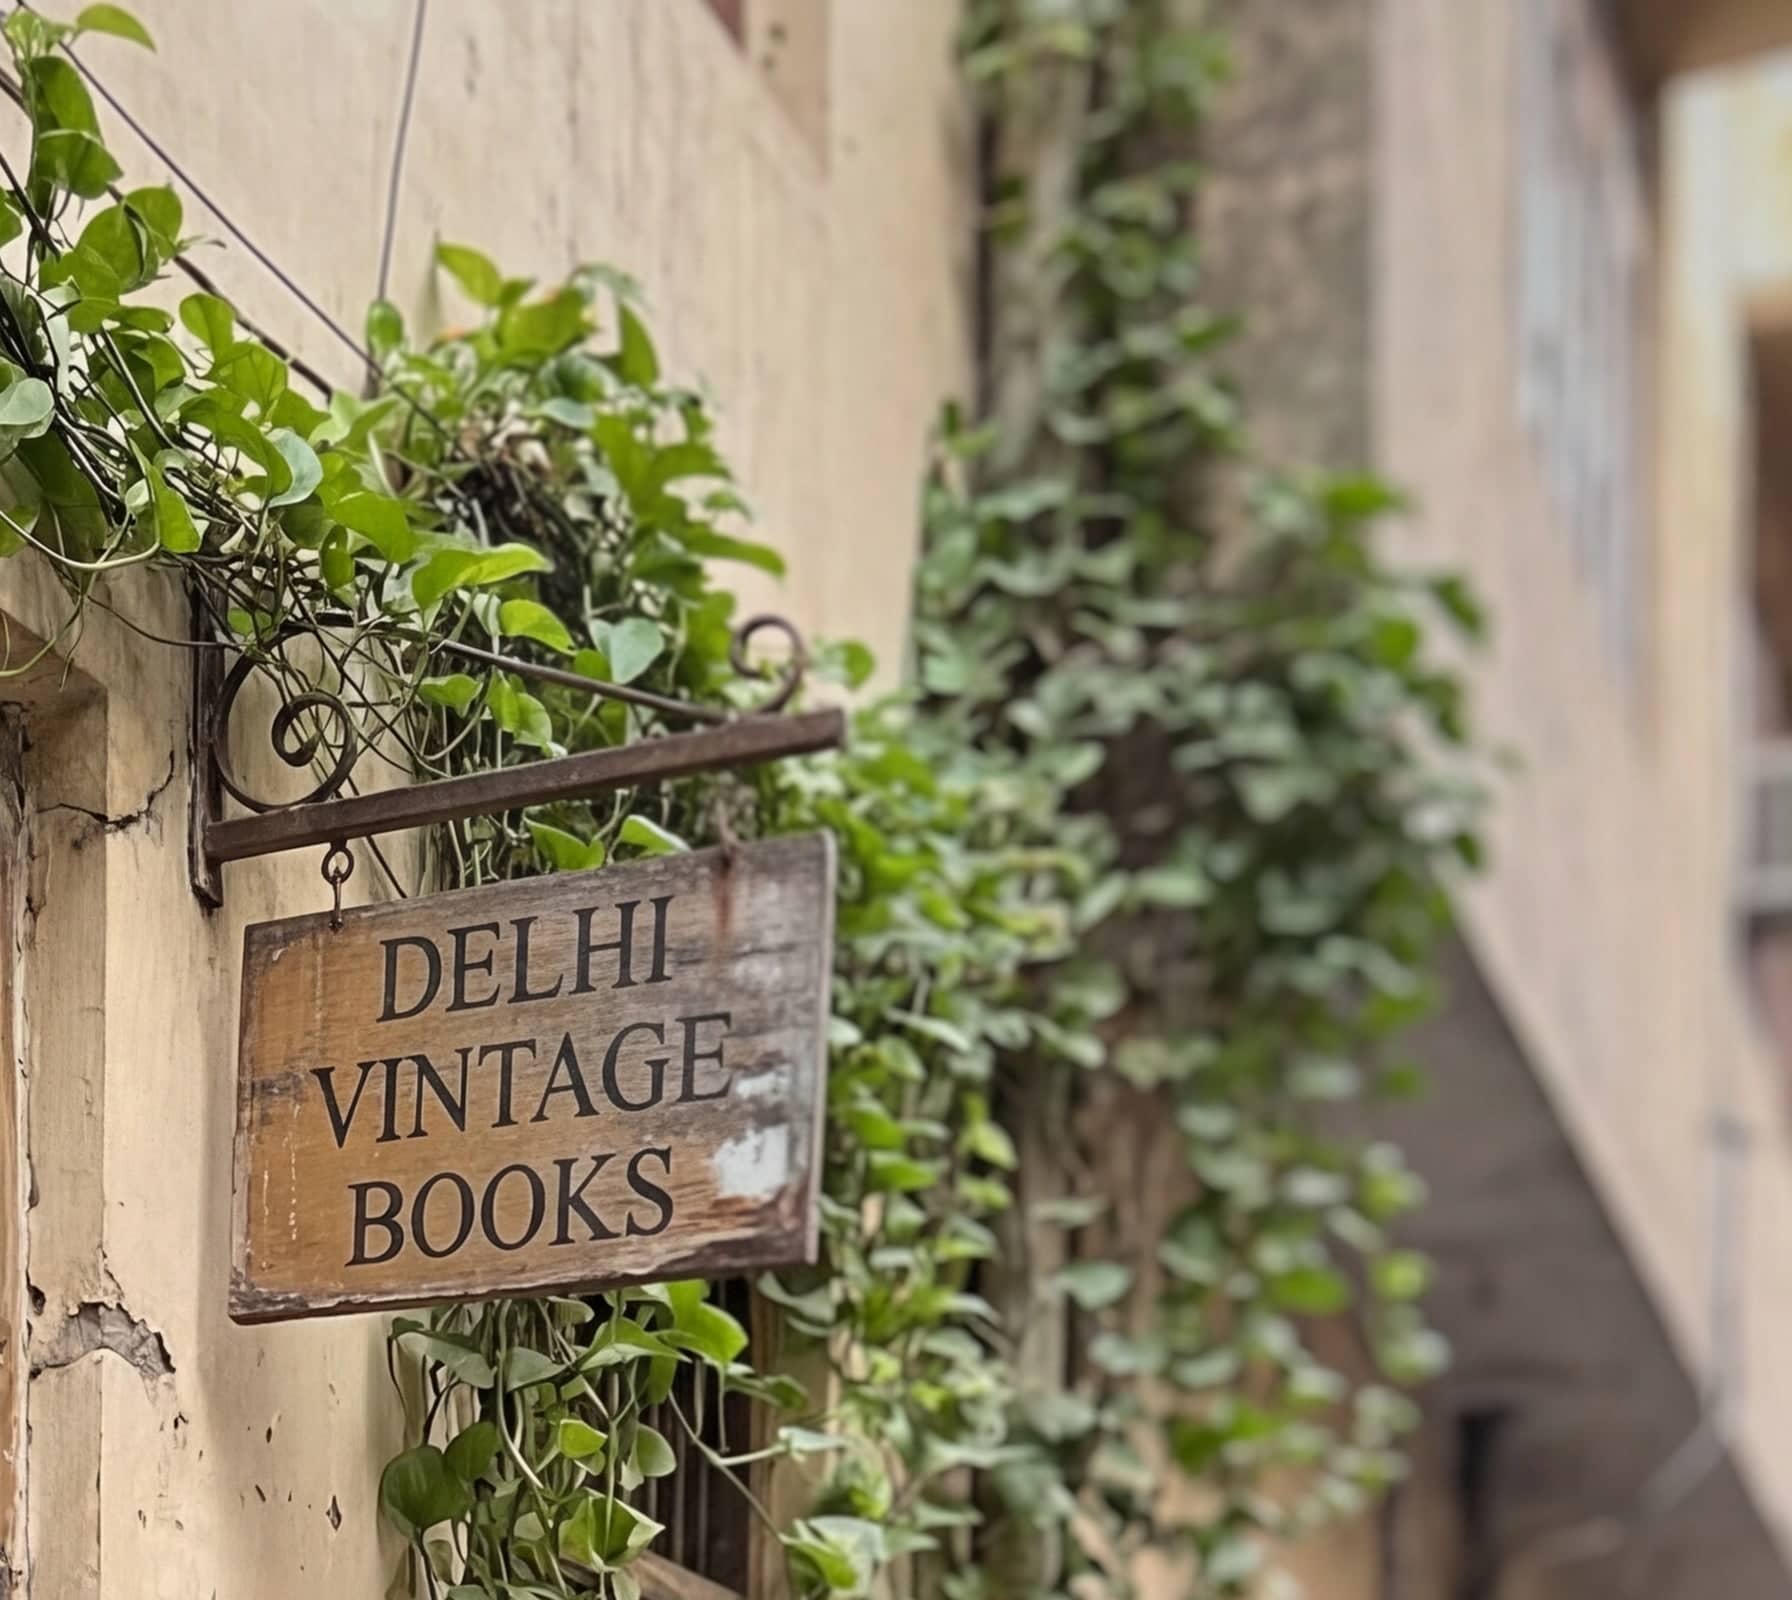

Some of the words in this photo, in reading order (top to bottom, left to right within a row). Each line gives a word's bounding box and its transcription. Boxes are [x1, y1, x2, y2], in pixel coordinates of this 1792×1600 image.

[375, 895, 676, 1023] DELHI
[310, 1011, 733, 1149] VINTAGE
[344, 1145, 675, 1268] BOOKS
